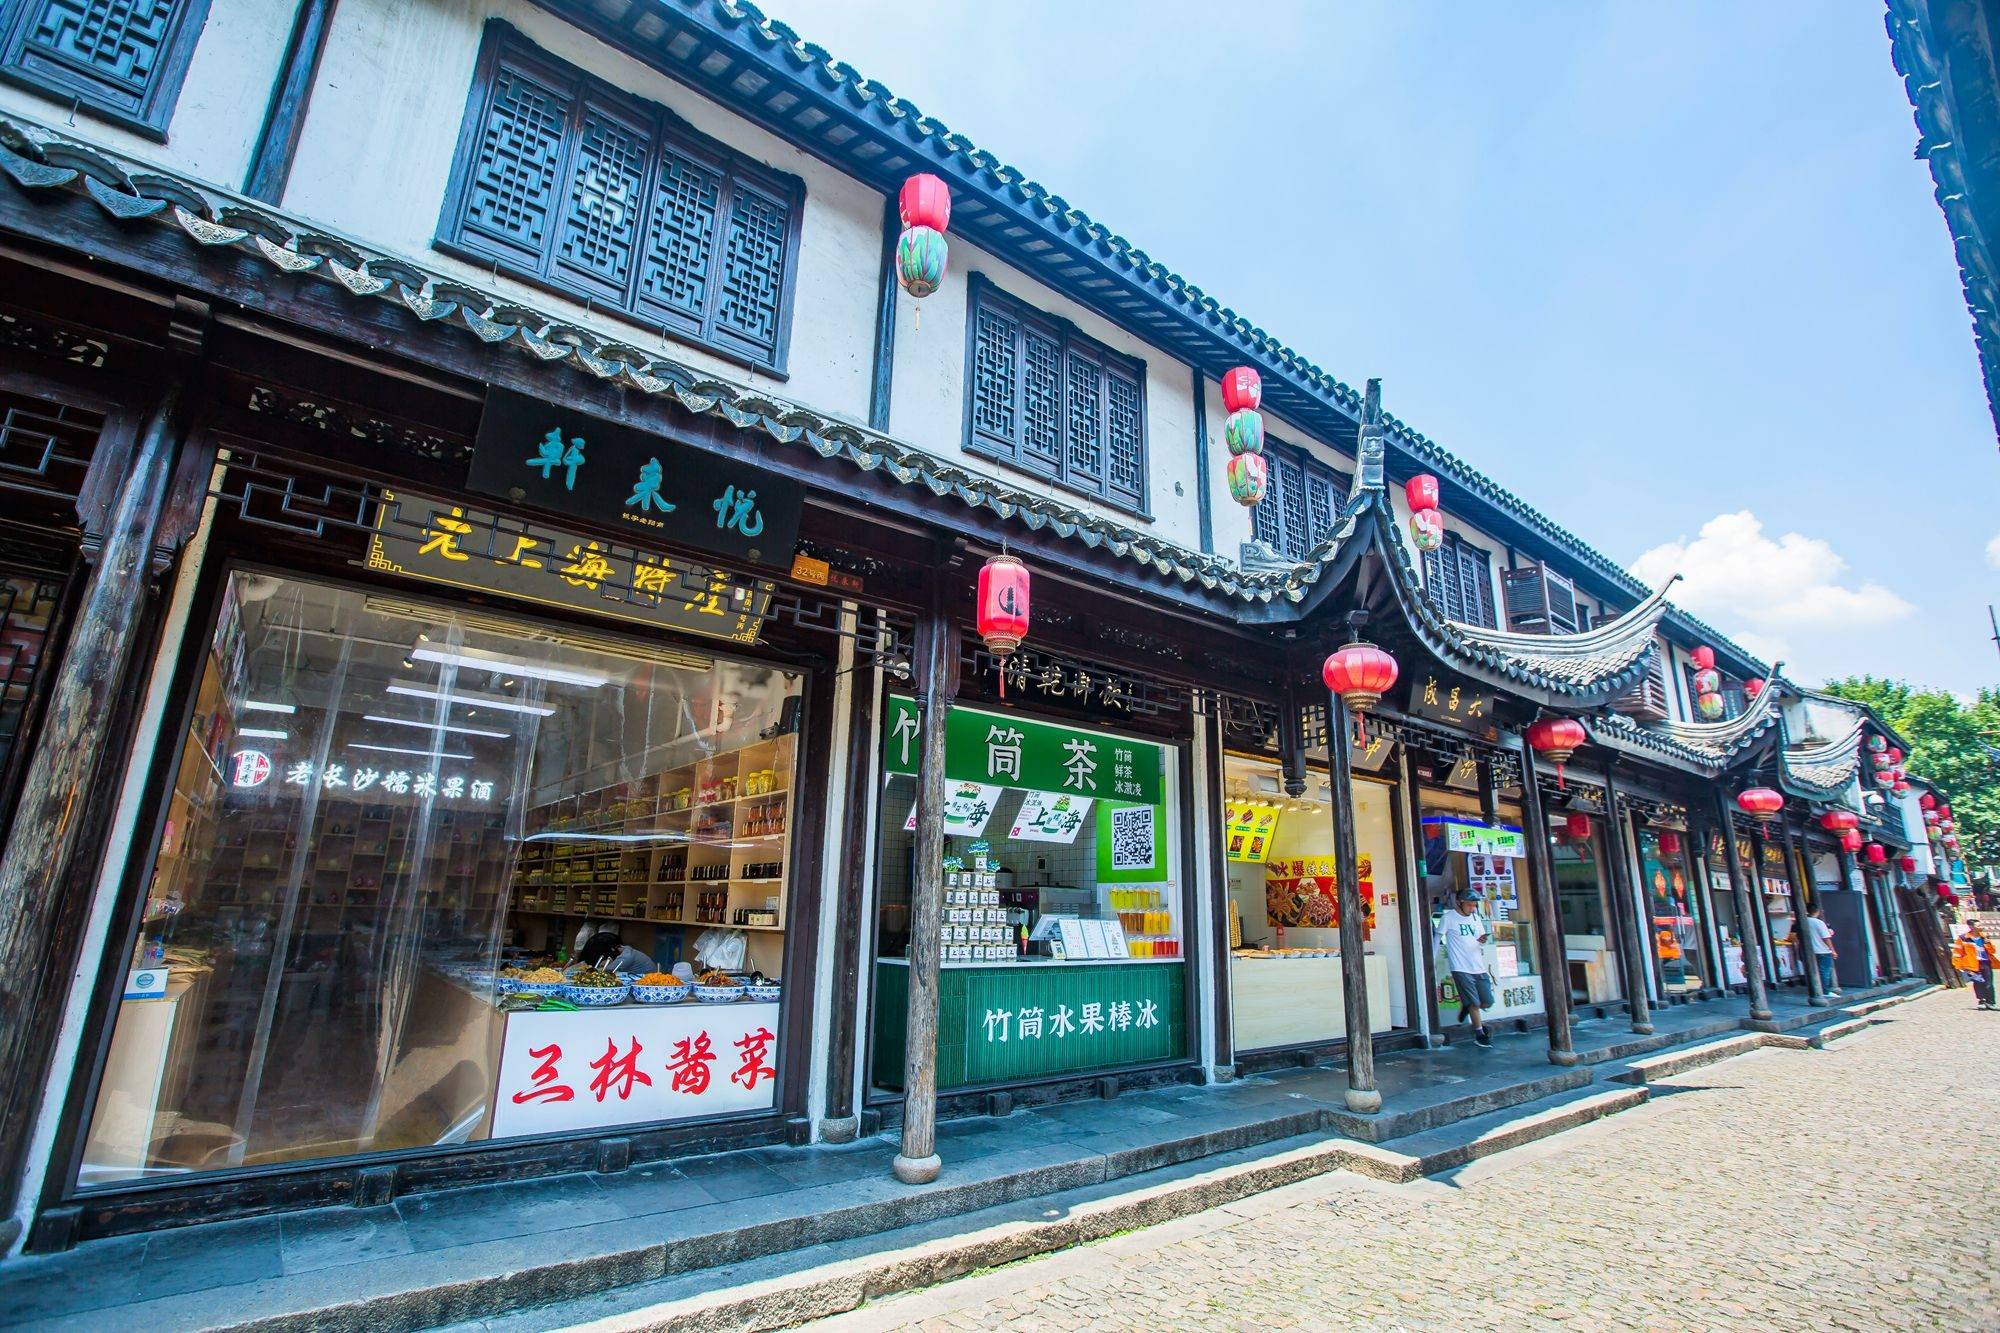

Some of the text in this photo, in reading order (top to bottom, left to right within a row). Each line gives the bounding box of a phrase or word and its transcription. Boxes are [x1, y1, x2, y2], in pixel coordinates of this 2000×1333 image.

[982, 999, 1159, 1044] 竹筒水果棒冰
